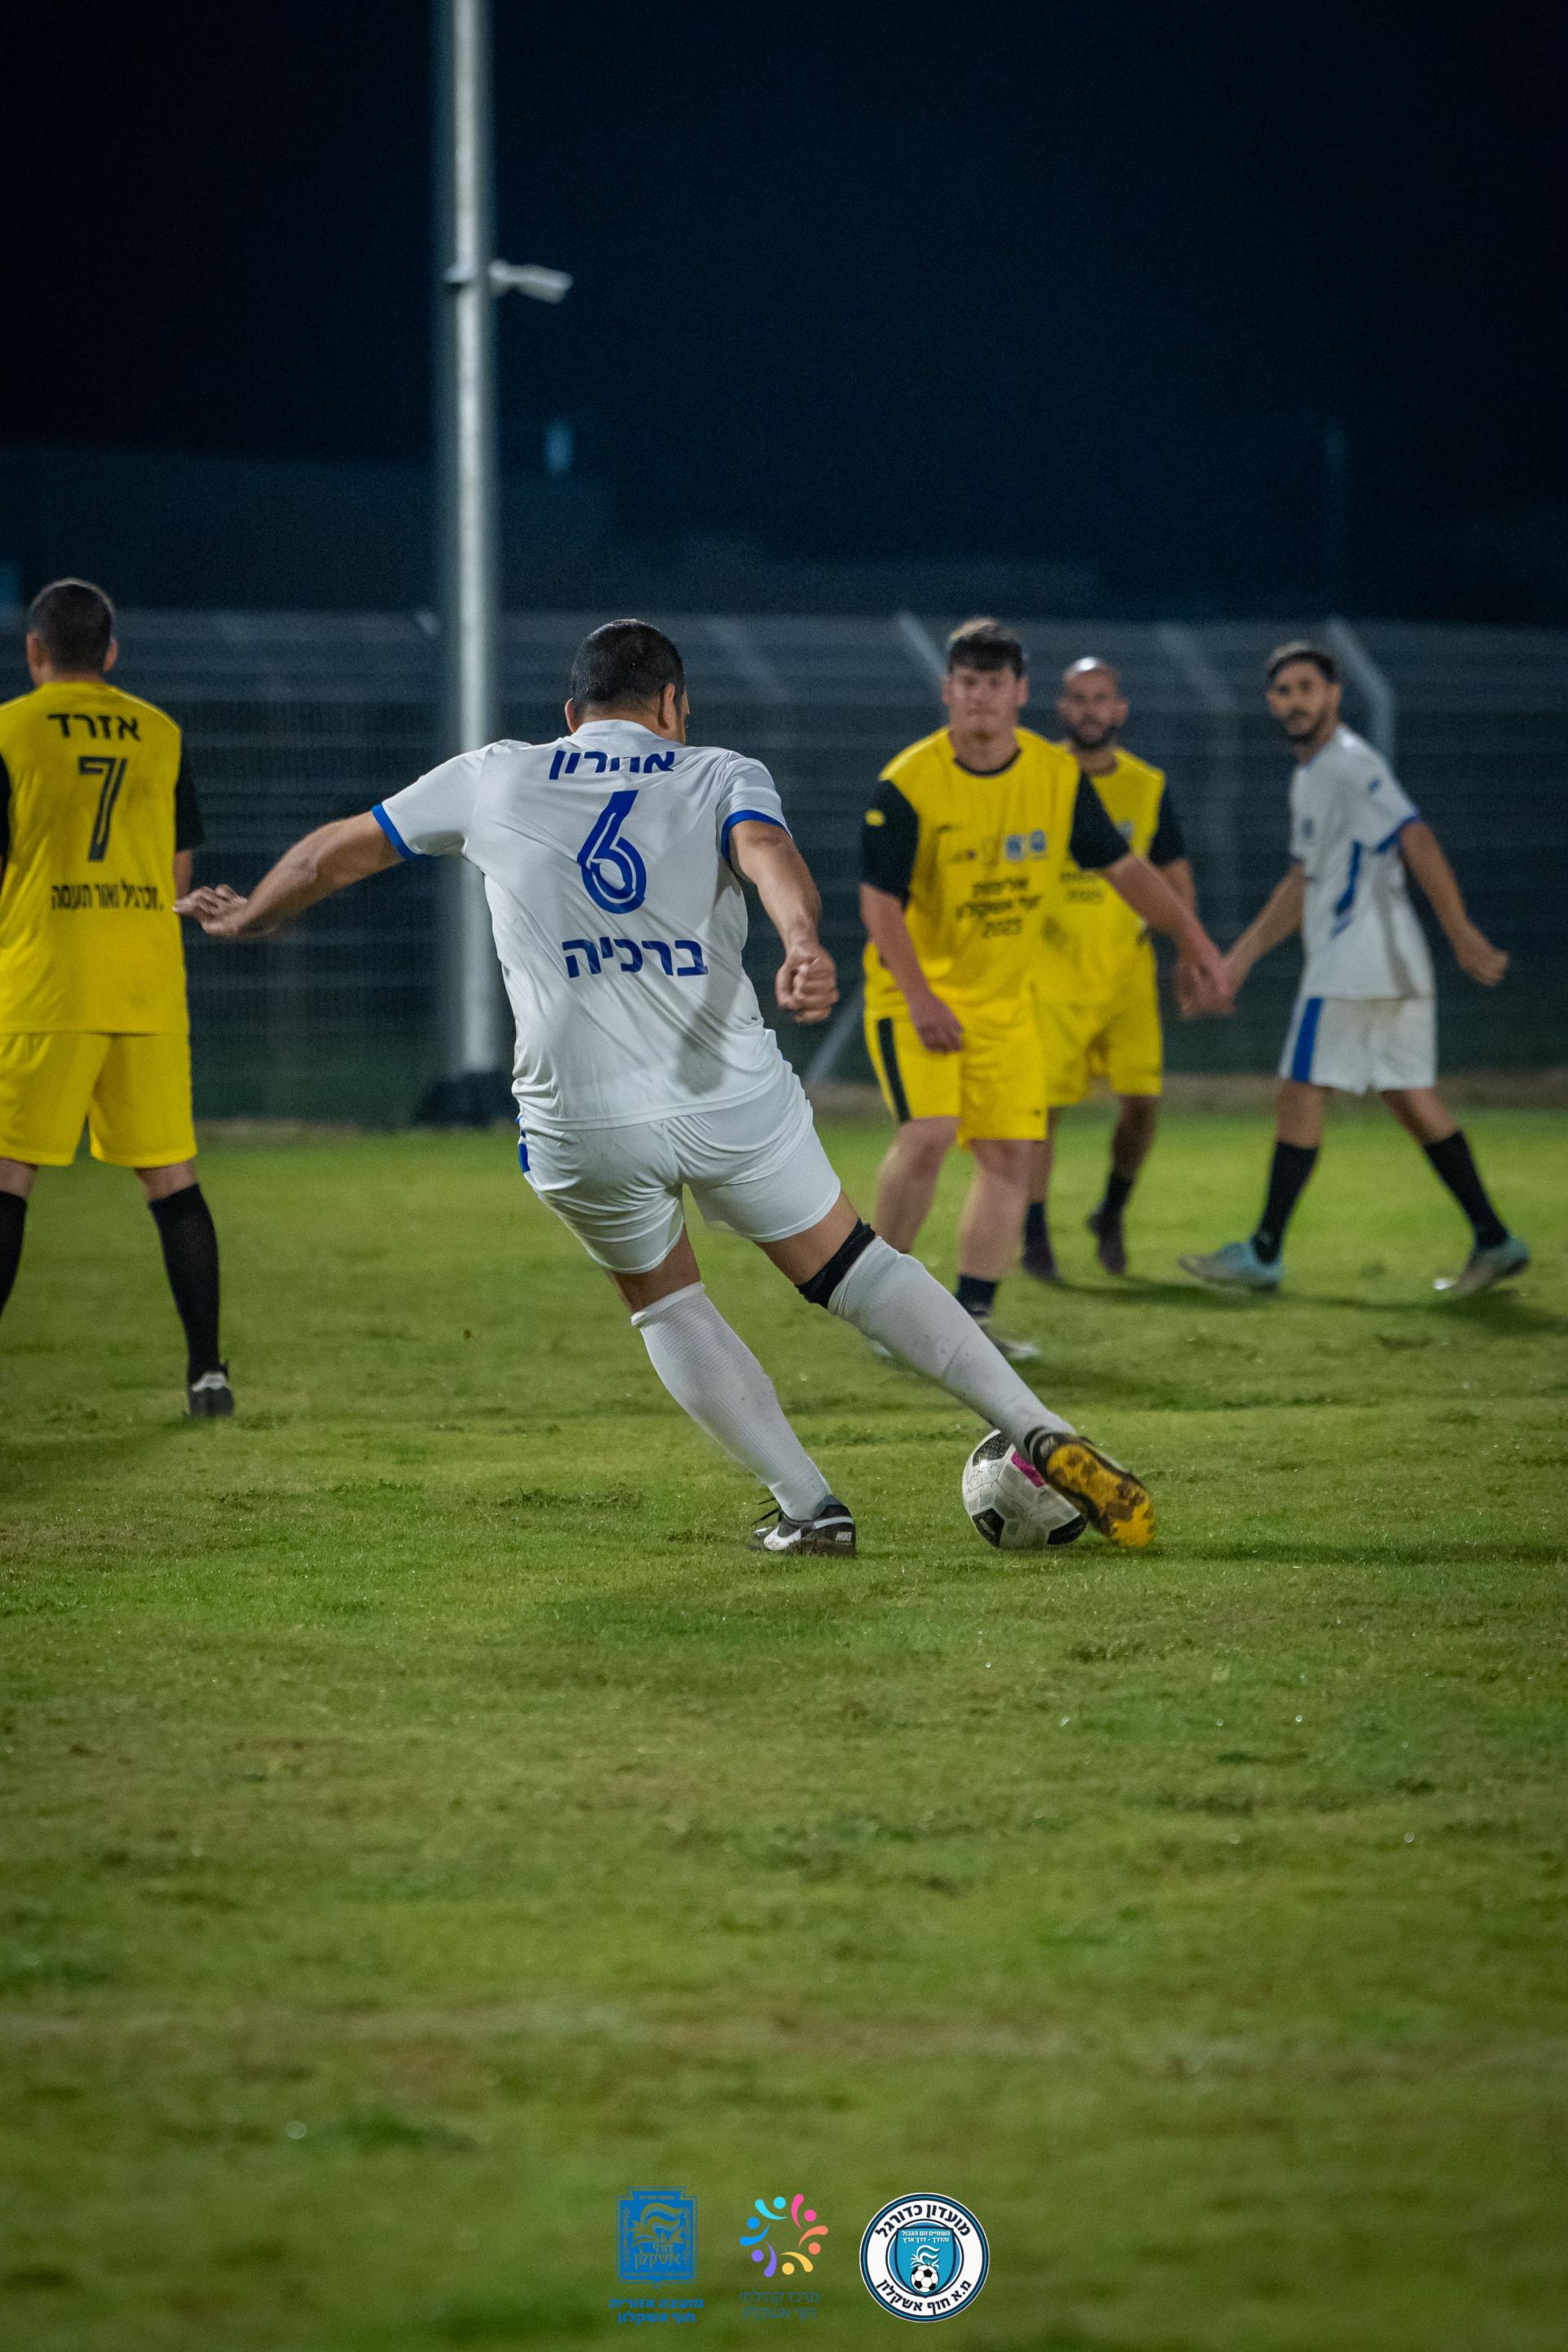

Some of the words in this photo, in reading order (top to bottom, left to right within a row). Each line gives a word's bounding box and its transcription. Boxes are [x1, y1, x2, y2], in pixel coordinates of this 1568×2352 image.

[78, 755, 127, 862] 7
[577, 790, 647, 914] 6
[561, 936, 709, 978] ברכיה
[835, 1531, 853, 1542] NIKE
